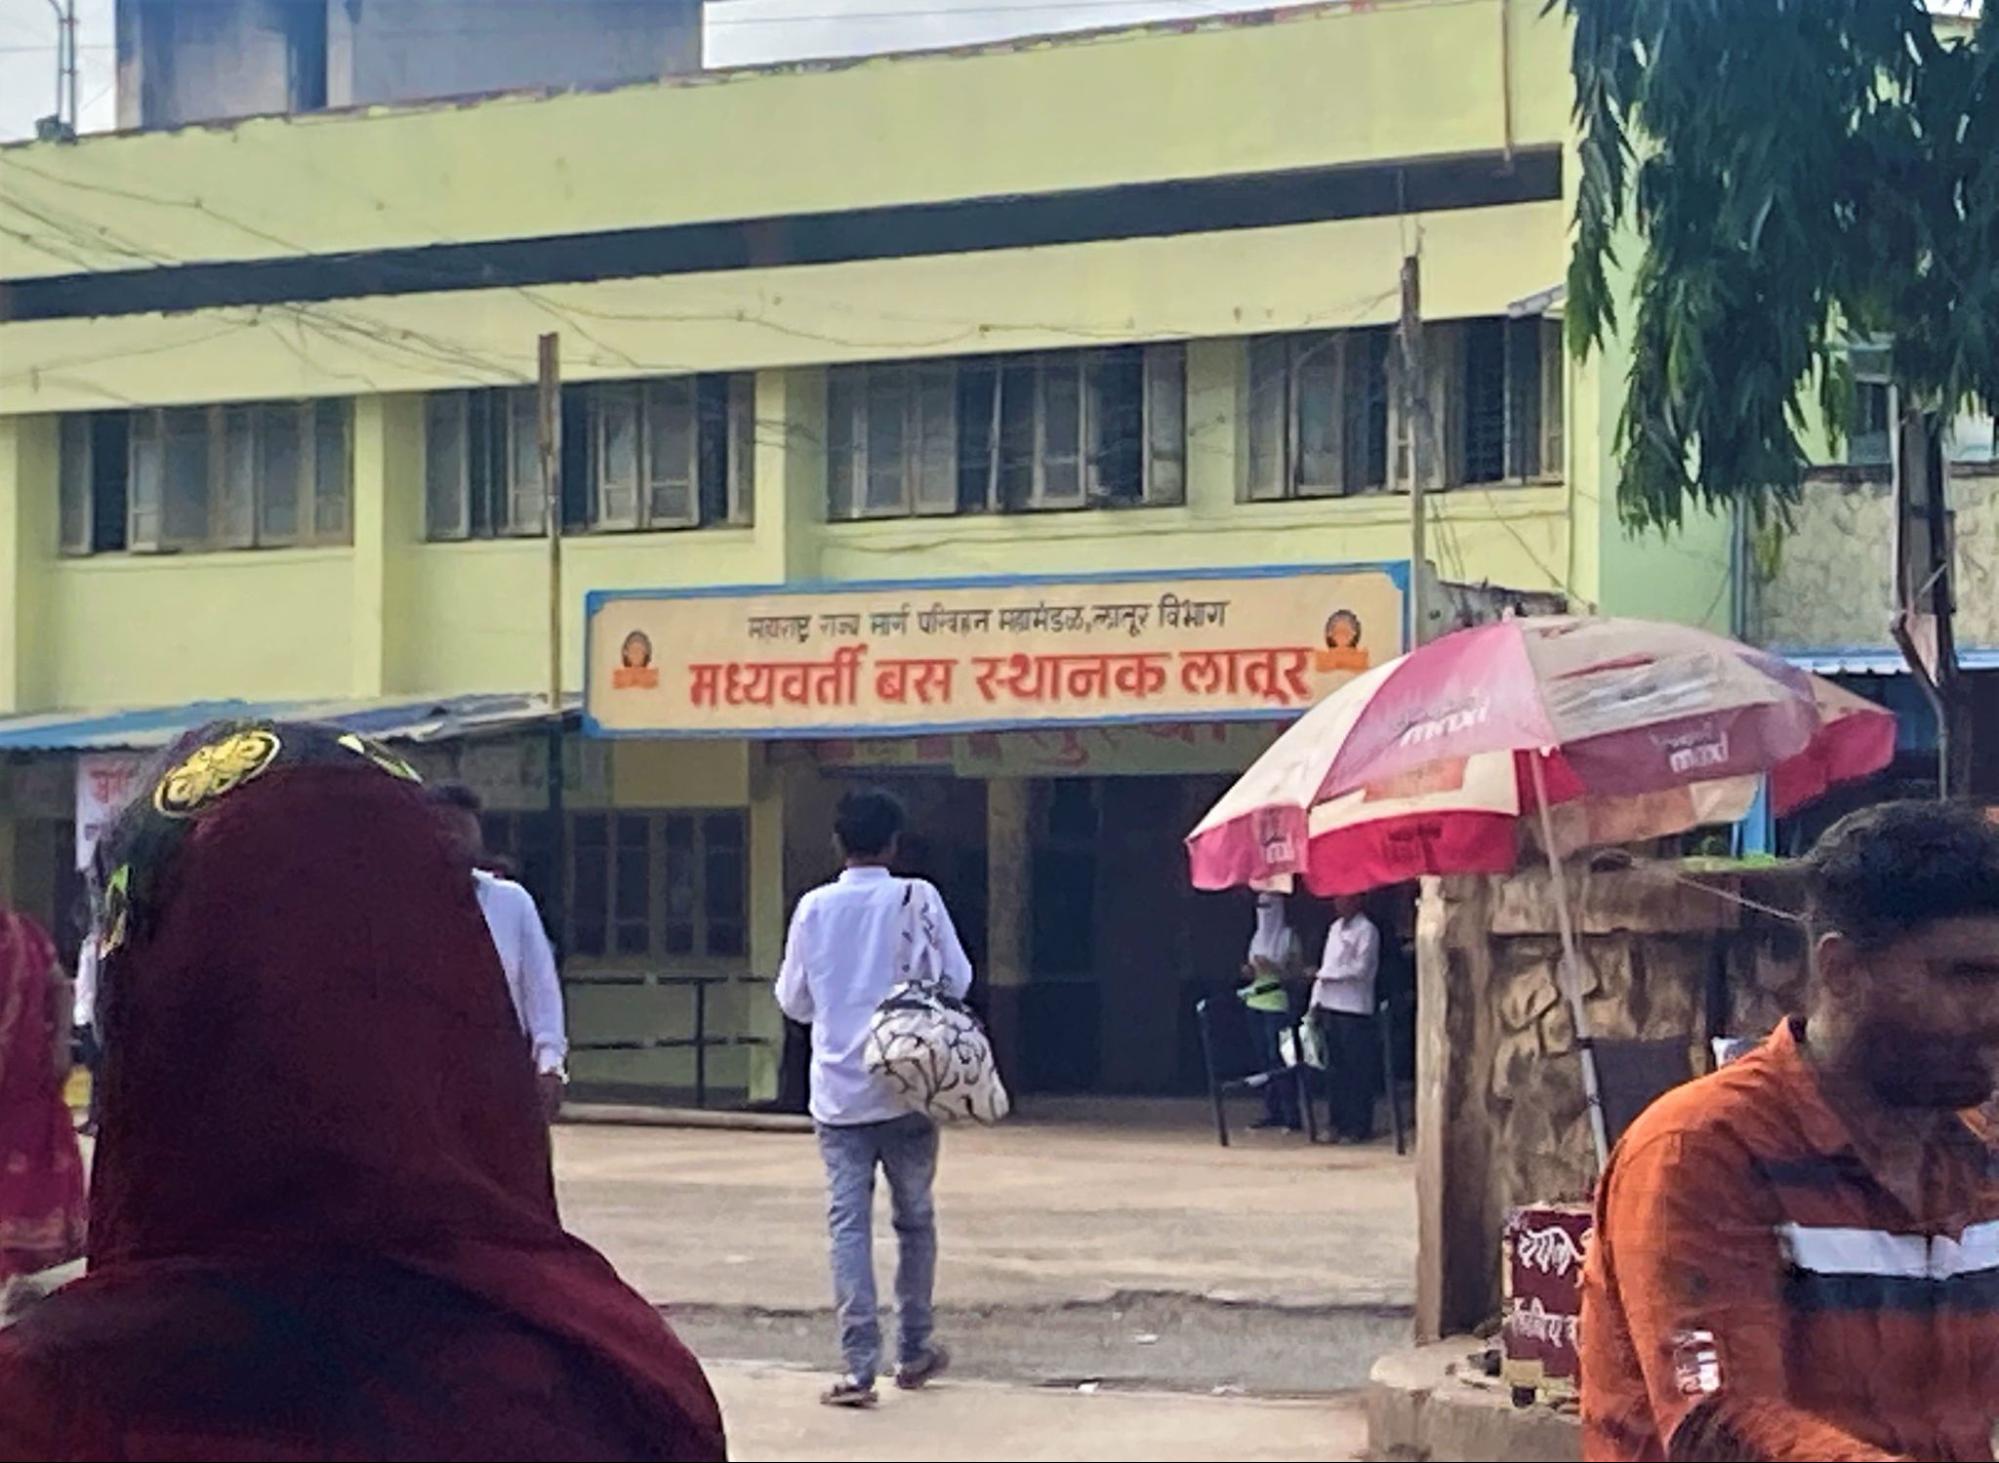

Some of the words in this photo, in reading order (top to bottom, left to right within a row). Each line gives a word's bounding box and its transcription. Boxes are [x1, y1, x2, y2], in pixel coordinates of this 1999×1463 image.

[819, 613, 860, 636] राज्य
[869, 602, 911, 635] मार्ग
[917, 602, 991, 636] परिवहन
[1158, 592, 1230, 628] विभाग
[688, 644, 868, 708] मध्यवर्ती
[875, 658, 958, 704] बस
[972, 651, 1171, 702] स्थानक
[1179, 646, 1316, 703] लातूर
